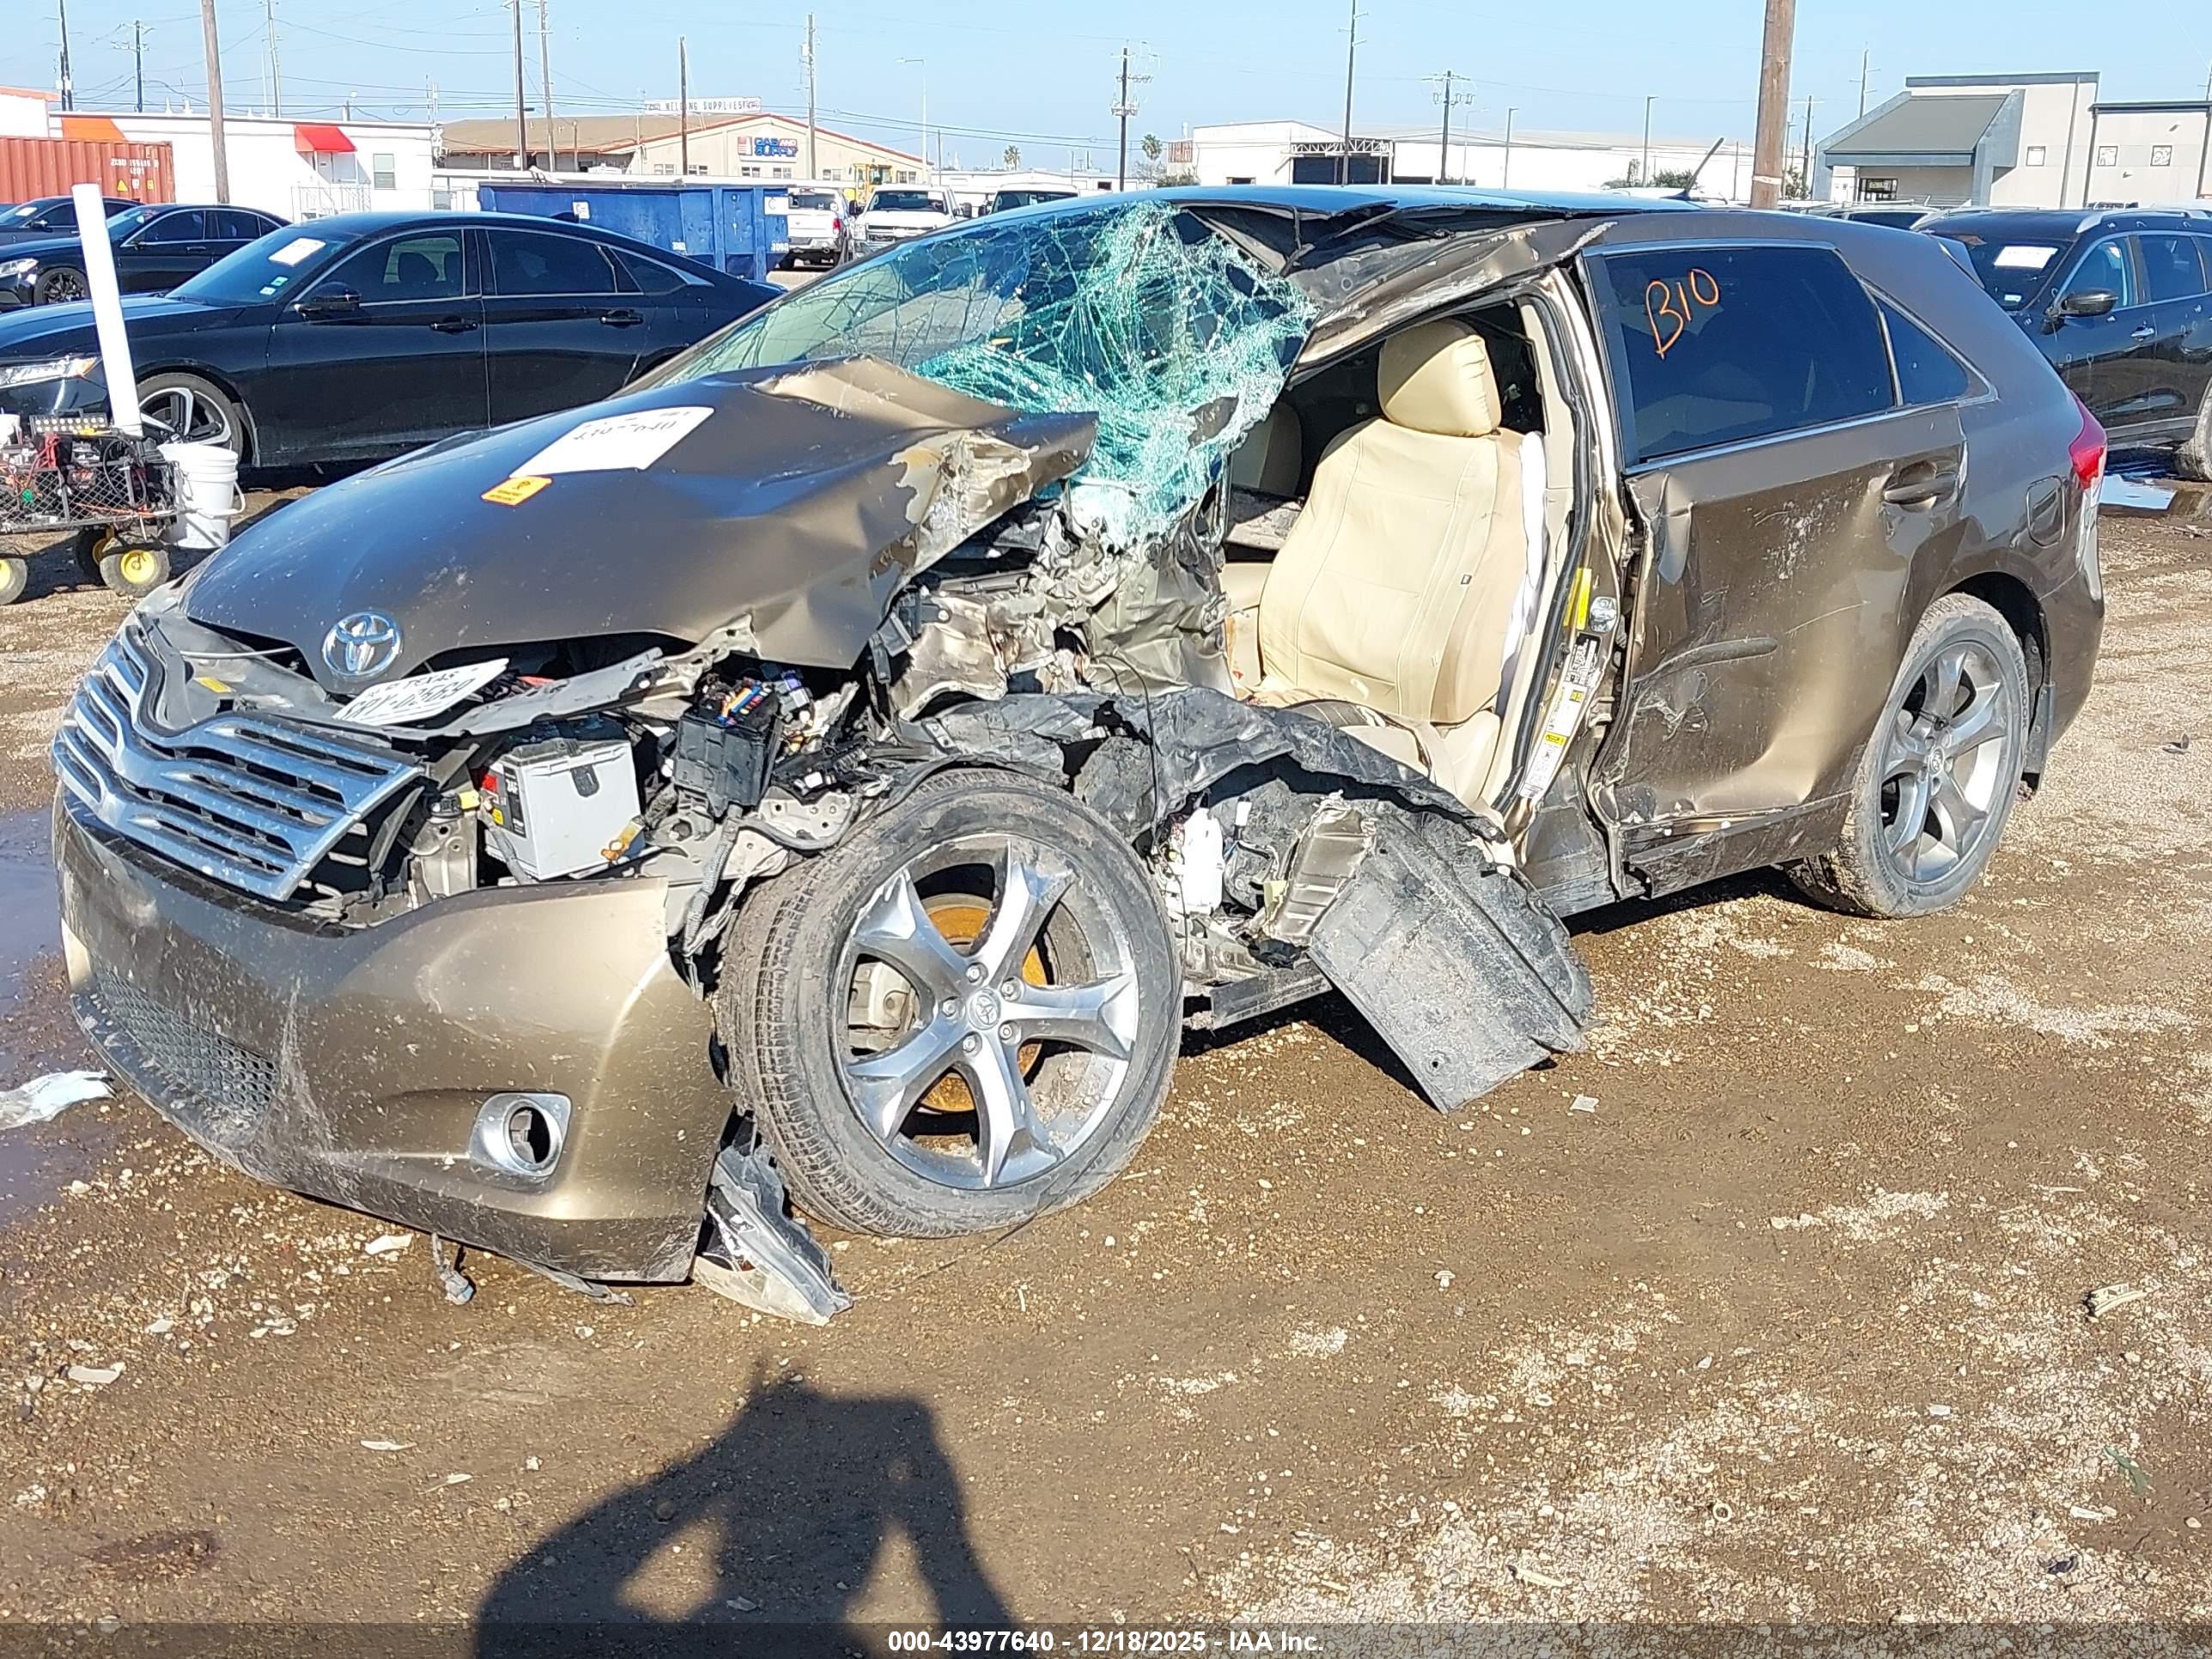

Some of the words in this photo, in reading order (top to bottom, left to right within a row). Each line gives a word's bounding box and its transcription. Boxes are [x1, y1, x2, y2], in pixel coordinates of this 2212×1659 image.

[703, 101, 743, 110] SUPPLIES
[755, 137, 778, 146] GAS
[755, 146, 798, 157] SUPPLY
